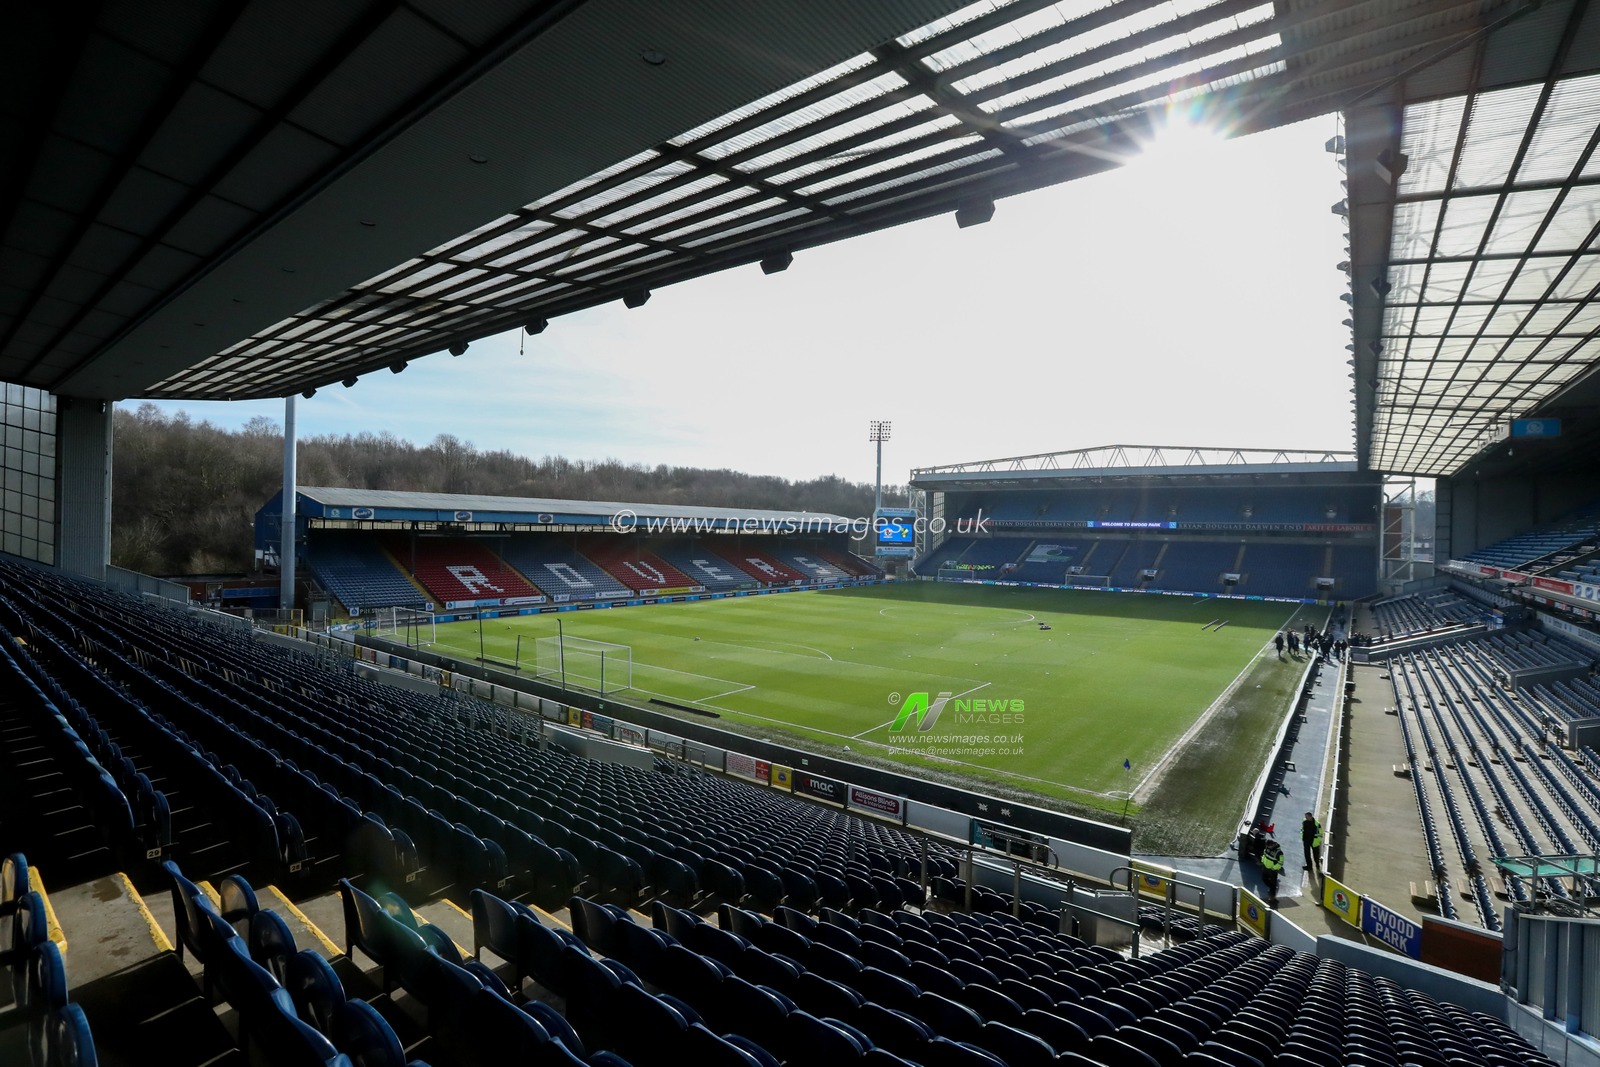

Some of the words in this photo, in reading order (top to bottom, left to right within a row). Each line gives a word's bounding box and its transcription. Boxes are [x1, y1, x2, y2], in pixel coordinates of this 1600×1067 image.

[855, 790, 878, 803] Allisons
[877, 796, 896, 808] Blinds
[148, 849, 160, 858] 29
[1370, 903, 1415, 939] EWOOD
[1375, 921, 1408, 953] PARK
